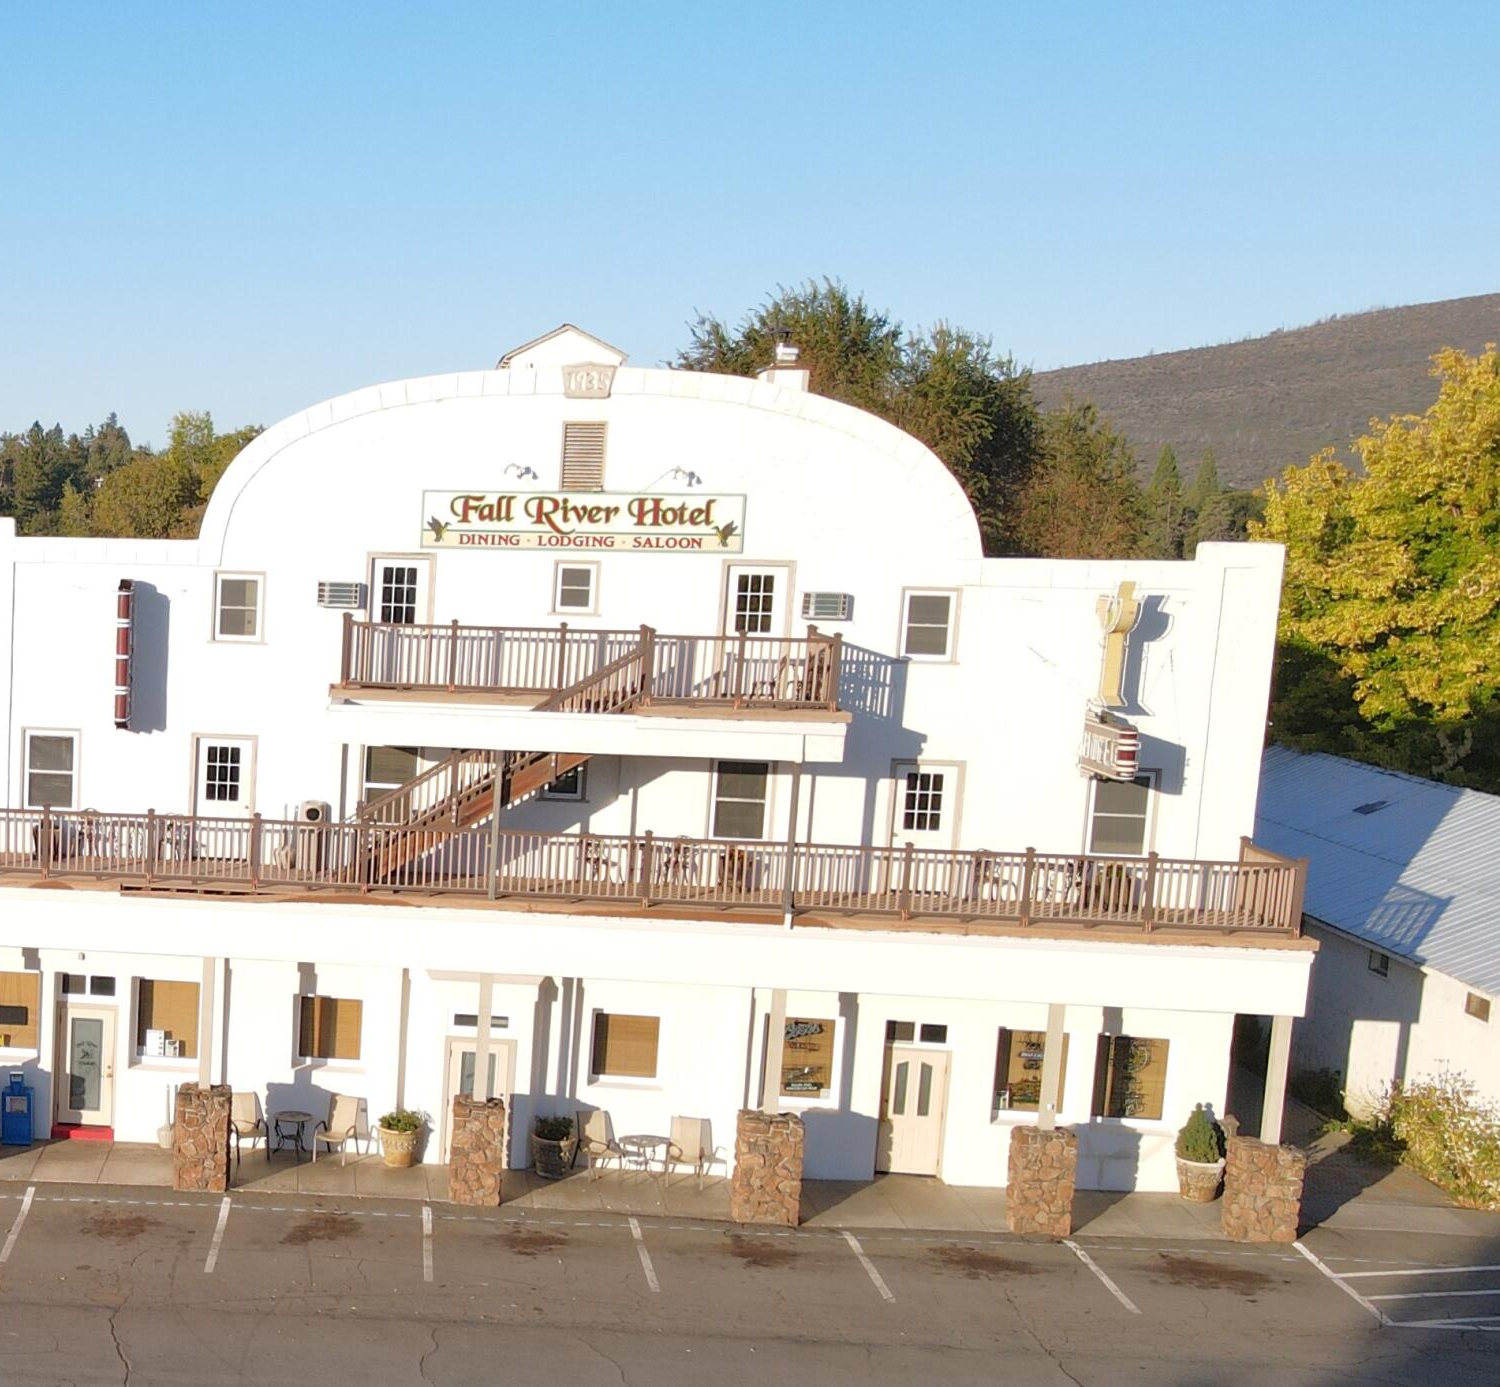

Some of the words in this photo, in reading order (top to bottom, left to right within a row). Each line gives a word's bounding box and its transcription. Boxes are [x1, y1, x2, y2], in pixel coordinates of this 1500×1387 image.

[450, 494, 517, 523] Fall
[524, 495, 620, 535] River
[627, 497, 717, 526] Hotel
[459, 533, 520, 546] DINING
[537, 535, 615, 548] LODGING
[632, 537, 703, 549] SALOON
